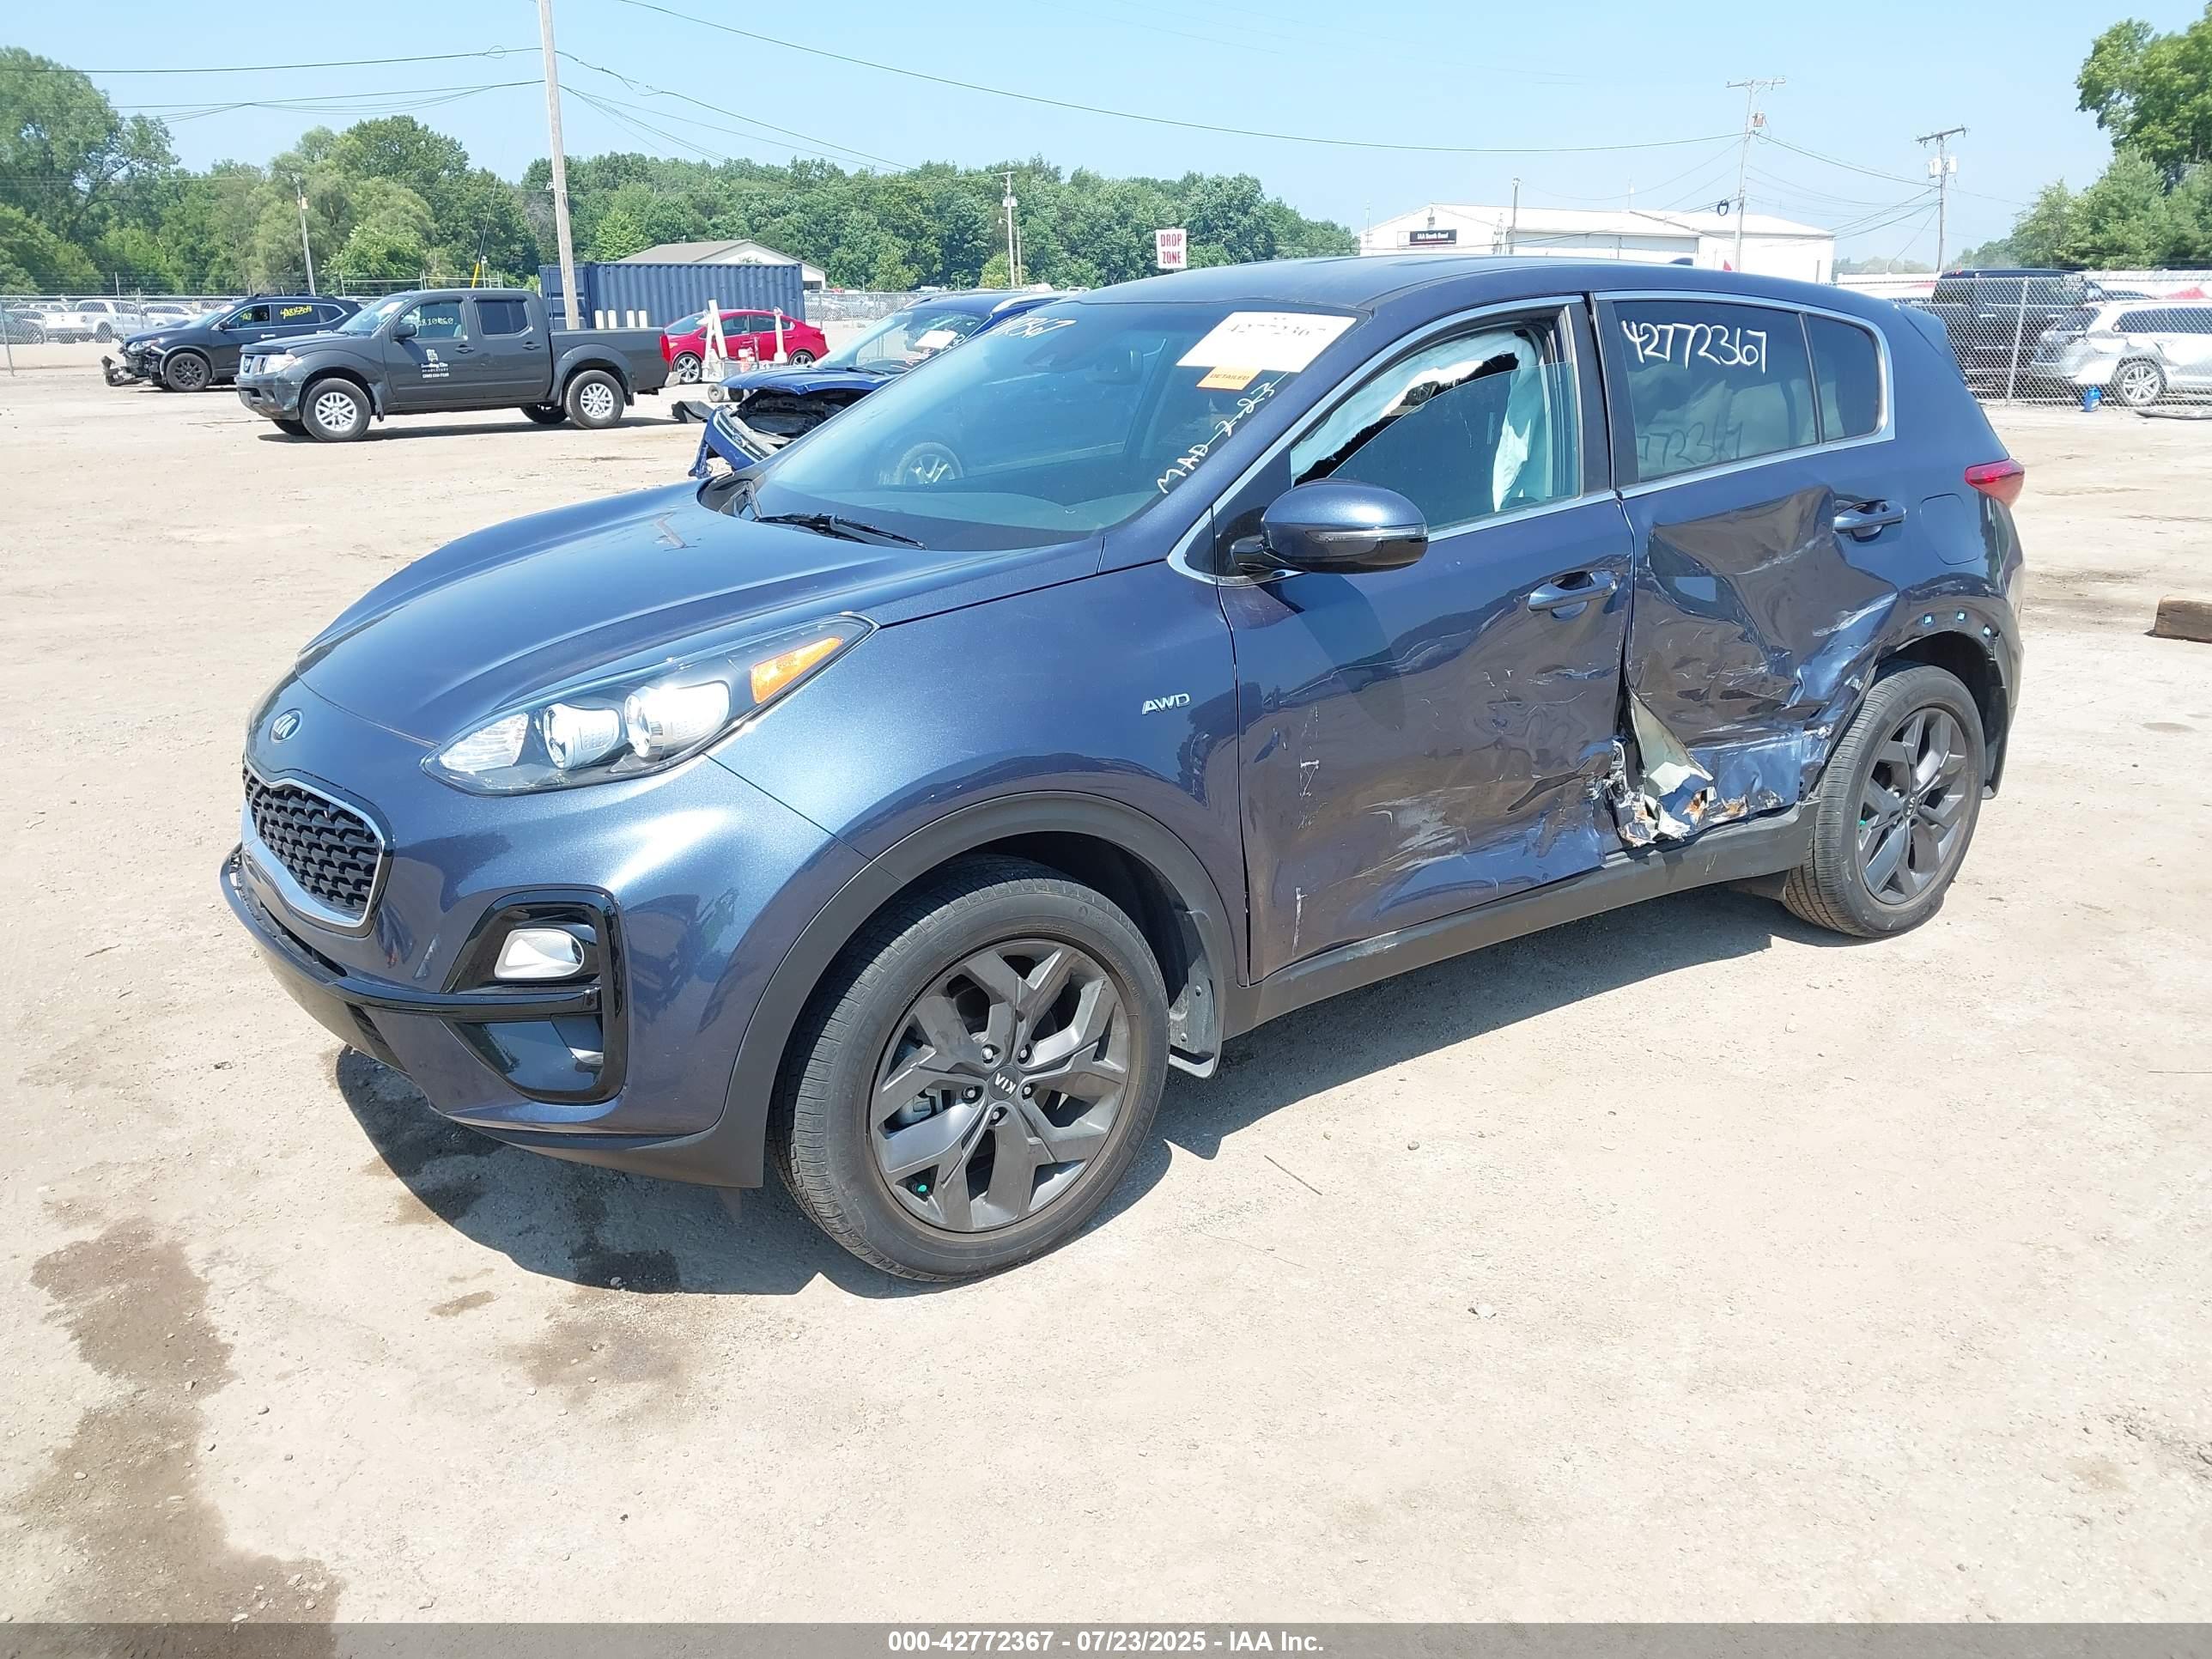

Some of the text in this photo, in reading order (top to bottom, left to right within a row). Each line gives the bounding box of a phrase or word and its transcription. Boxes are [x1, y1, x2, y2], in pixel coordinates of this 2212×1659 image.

[1160, 233, 1183, 247] DROP
[1162, 250, 1182, 264] ZONE
[1621, 319, 1766, 374] 42772367
[1209, 373, 1250, 381] DETAILED
[1141, 692, 1191, 716] AWD
[994, 1073, 1018, 1095] KIA
